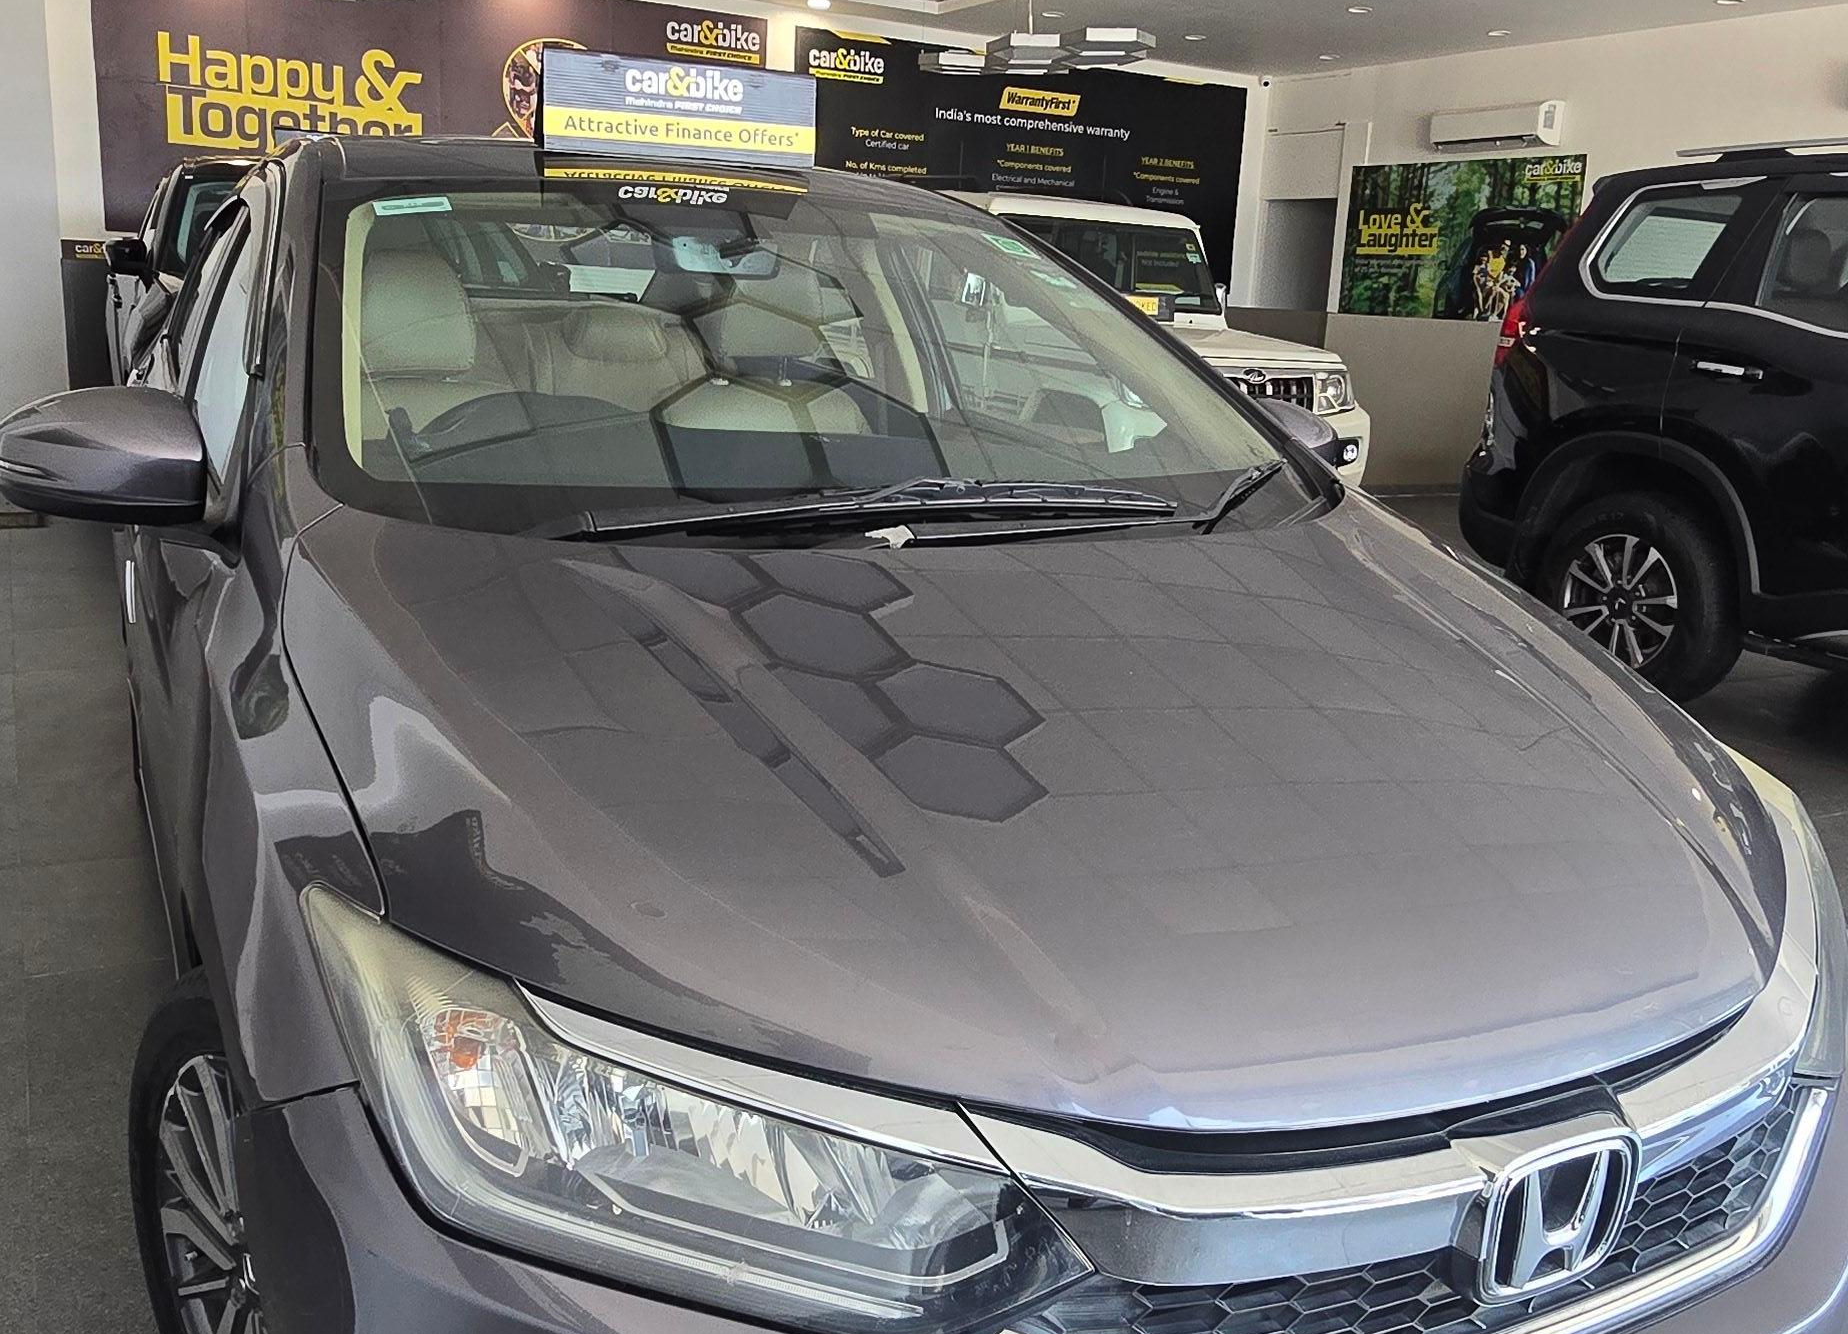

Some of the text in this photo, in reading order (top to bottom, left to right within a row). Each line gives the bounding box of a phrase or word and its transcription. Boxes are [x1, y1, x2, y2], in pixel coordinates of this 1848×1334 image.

[666, 20, 760, 51] car&bike
[157, 31, 422, 113] Happy &
[809, 48, 884, 74] car&bike
[625, 67, 743, 102] car&bike
[564, 115, 659, 137] Attractive
[665, 122, 733, 143] Finance
[851, 127, 924, 141] Type of Car covered
[935, 107, 1130, 141] India's most comprehensive warranty
[1006, 143, 1025, 153] YEAR
[1030, 145, 1064, 157] BENEFITS
[1141, 156, 1158, 166] YEAR
[887, 164, 927, 175] completed
[1044, 165, 1071, 173] covered
[1525, 159, 1583, 175] car&bike
[1023, 177, 1036, 185] and
[1358, 202, 1432, 229] Love &
[1357, 228, 1438, 253] Laughter
